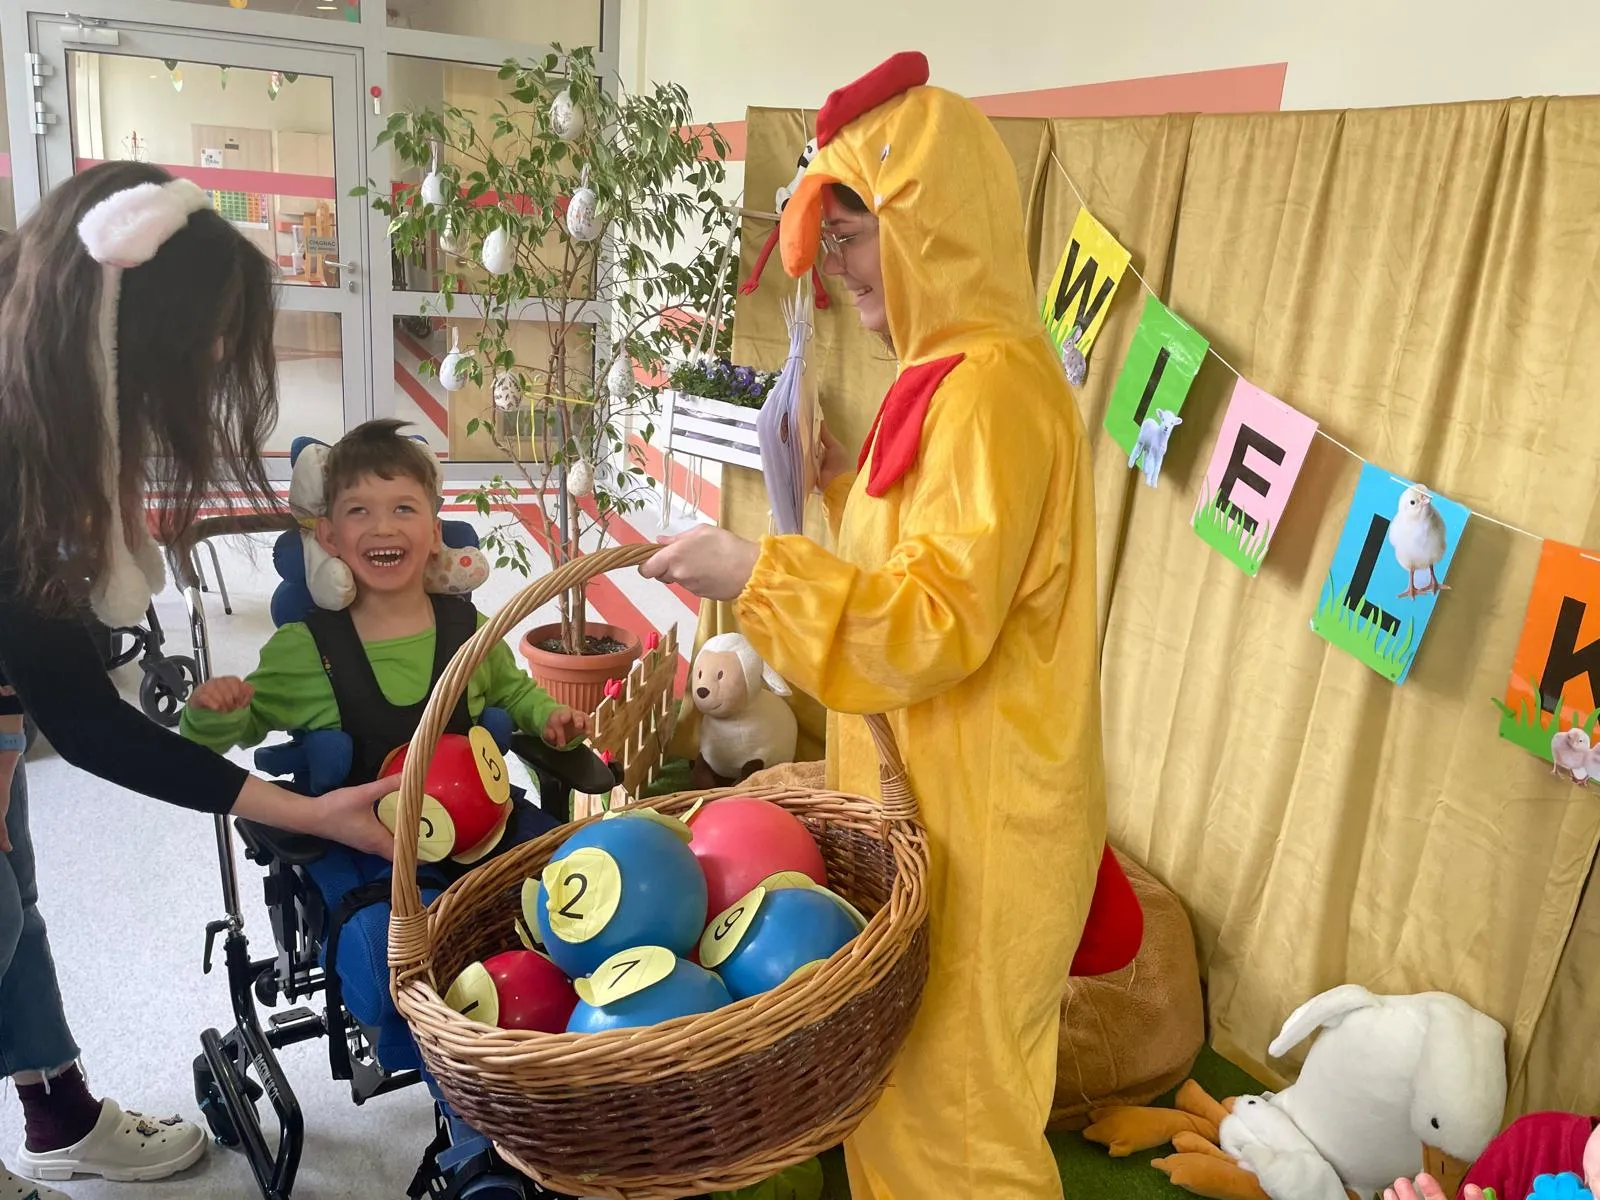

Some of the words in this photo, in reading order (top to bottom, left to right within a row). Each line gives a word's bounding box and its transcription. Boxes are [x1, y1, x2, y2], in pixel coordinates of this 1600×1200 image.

[482, 746, 501, 781] 5
[559, 873, 588, 920] 2
[610, 960, 641, 989] 7
